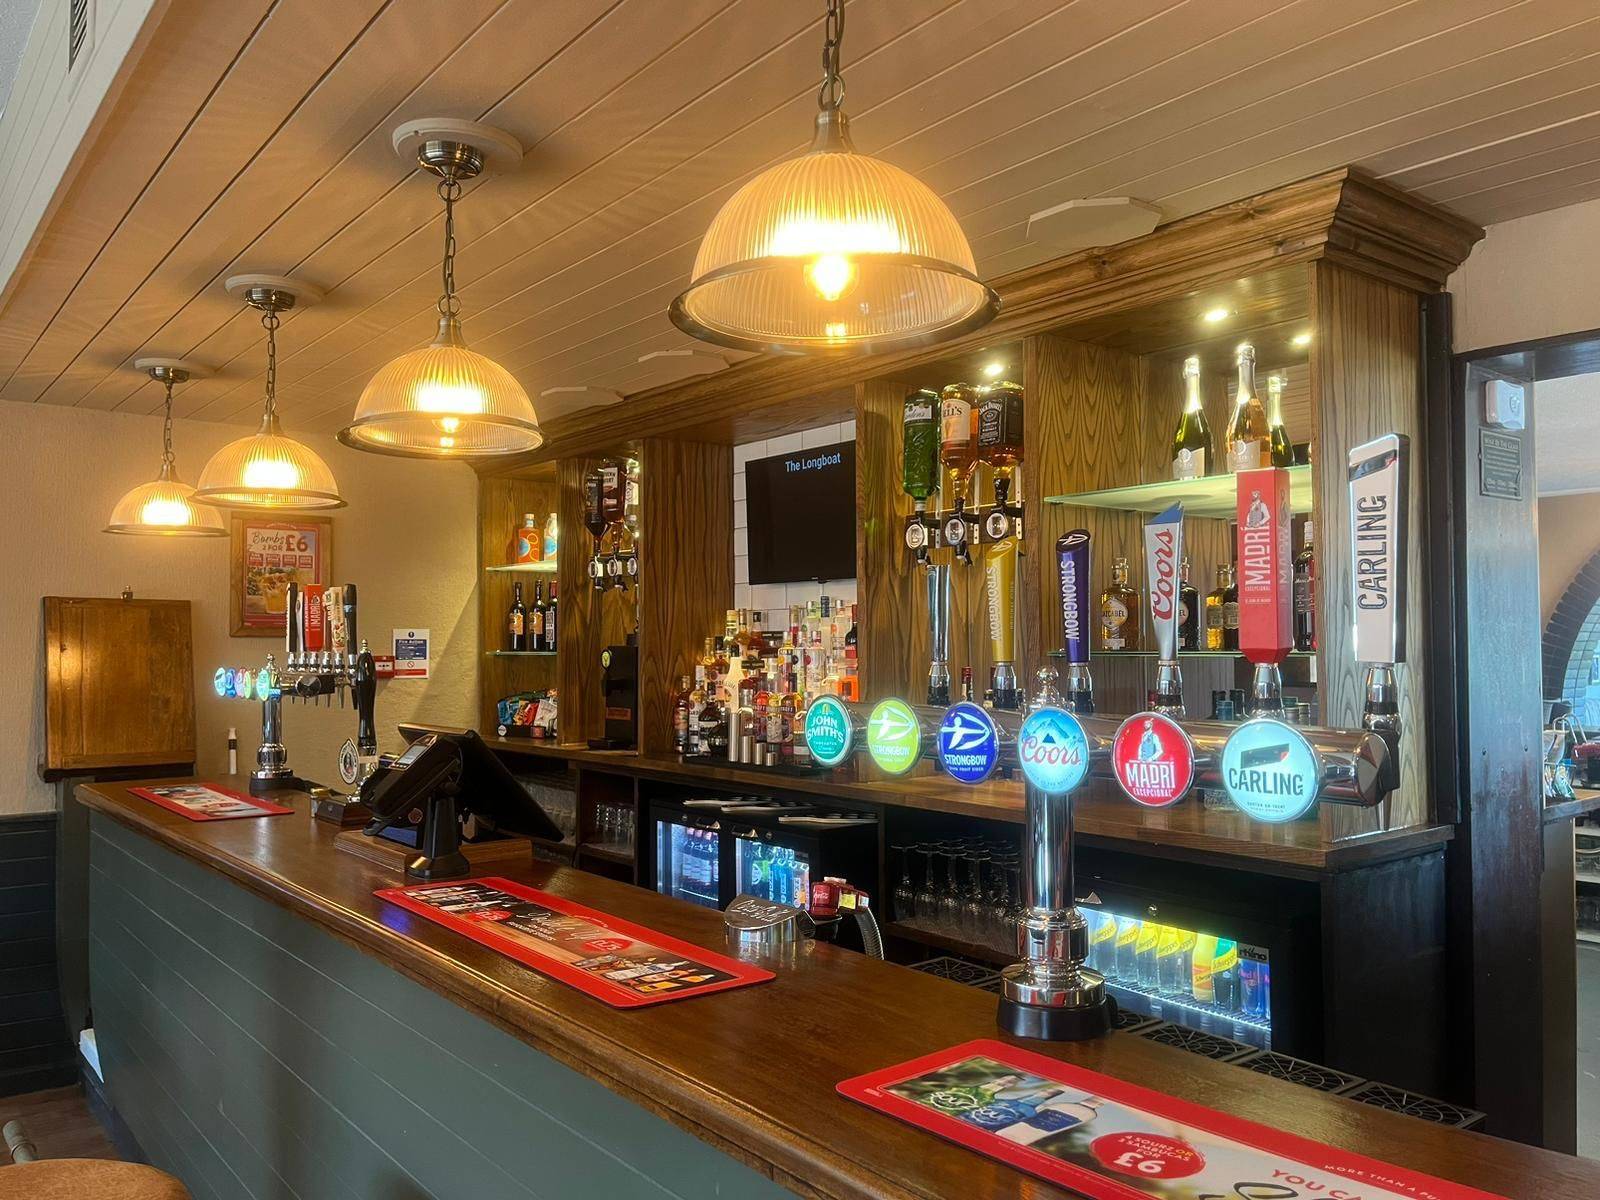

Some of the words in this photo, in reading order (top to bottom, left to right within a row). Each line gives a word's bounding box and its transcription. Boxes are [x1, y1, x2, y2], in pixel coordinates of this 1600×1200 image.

[785, 460, 801, 472] The
[802, 452, 841, 470] Longboat
[252, 531, 285, 545] Bombs
[285, 534, 308, 552] £6
[1357, 495, 1387, 610] CARLING
[1151, 529, 1174, 621] Coors
[986, 567, 1002, 640] STRONGBOW
[1060, 560, 1080, 640] STRONGBOW
[811, 716, 838, 727] JOHN
[807, 725, 844, 743] SMITH'S
[873, 744, 910, 756] STRONGBOW
[944, 754, 988, 766] STRONGBOW
[1021, 736, 1081, 765] Coors
[1125, 758, 1176, 789] MADRÍ
[1229, 768, 1304, 796] CARLING
[1126, 1140, 1190, 1162] SAMBUCAS
[1135, 1137, 1175, 1151] SOURZ
[1175, 1149, 1194, 1157] OR
[1136, 1148, 1161, 1158] FOR
[1113, 1152, 1166, 1174] £6
[1272, 1168, 1326, 1191] YOU
[1324, 1164, 1365, 1176] MORE
[1370, 1174, 1405, 1188] THAN
